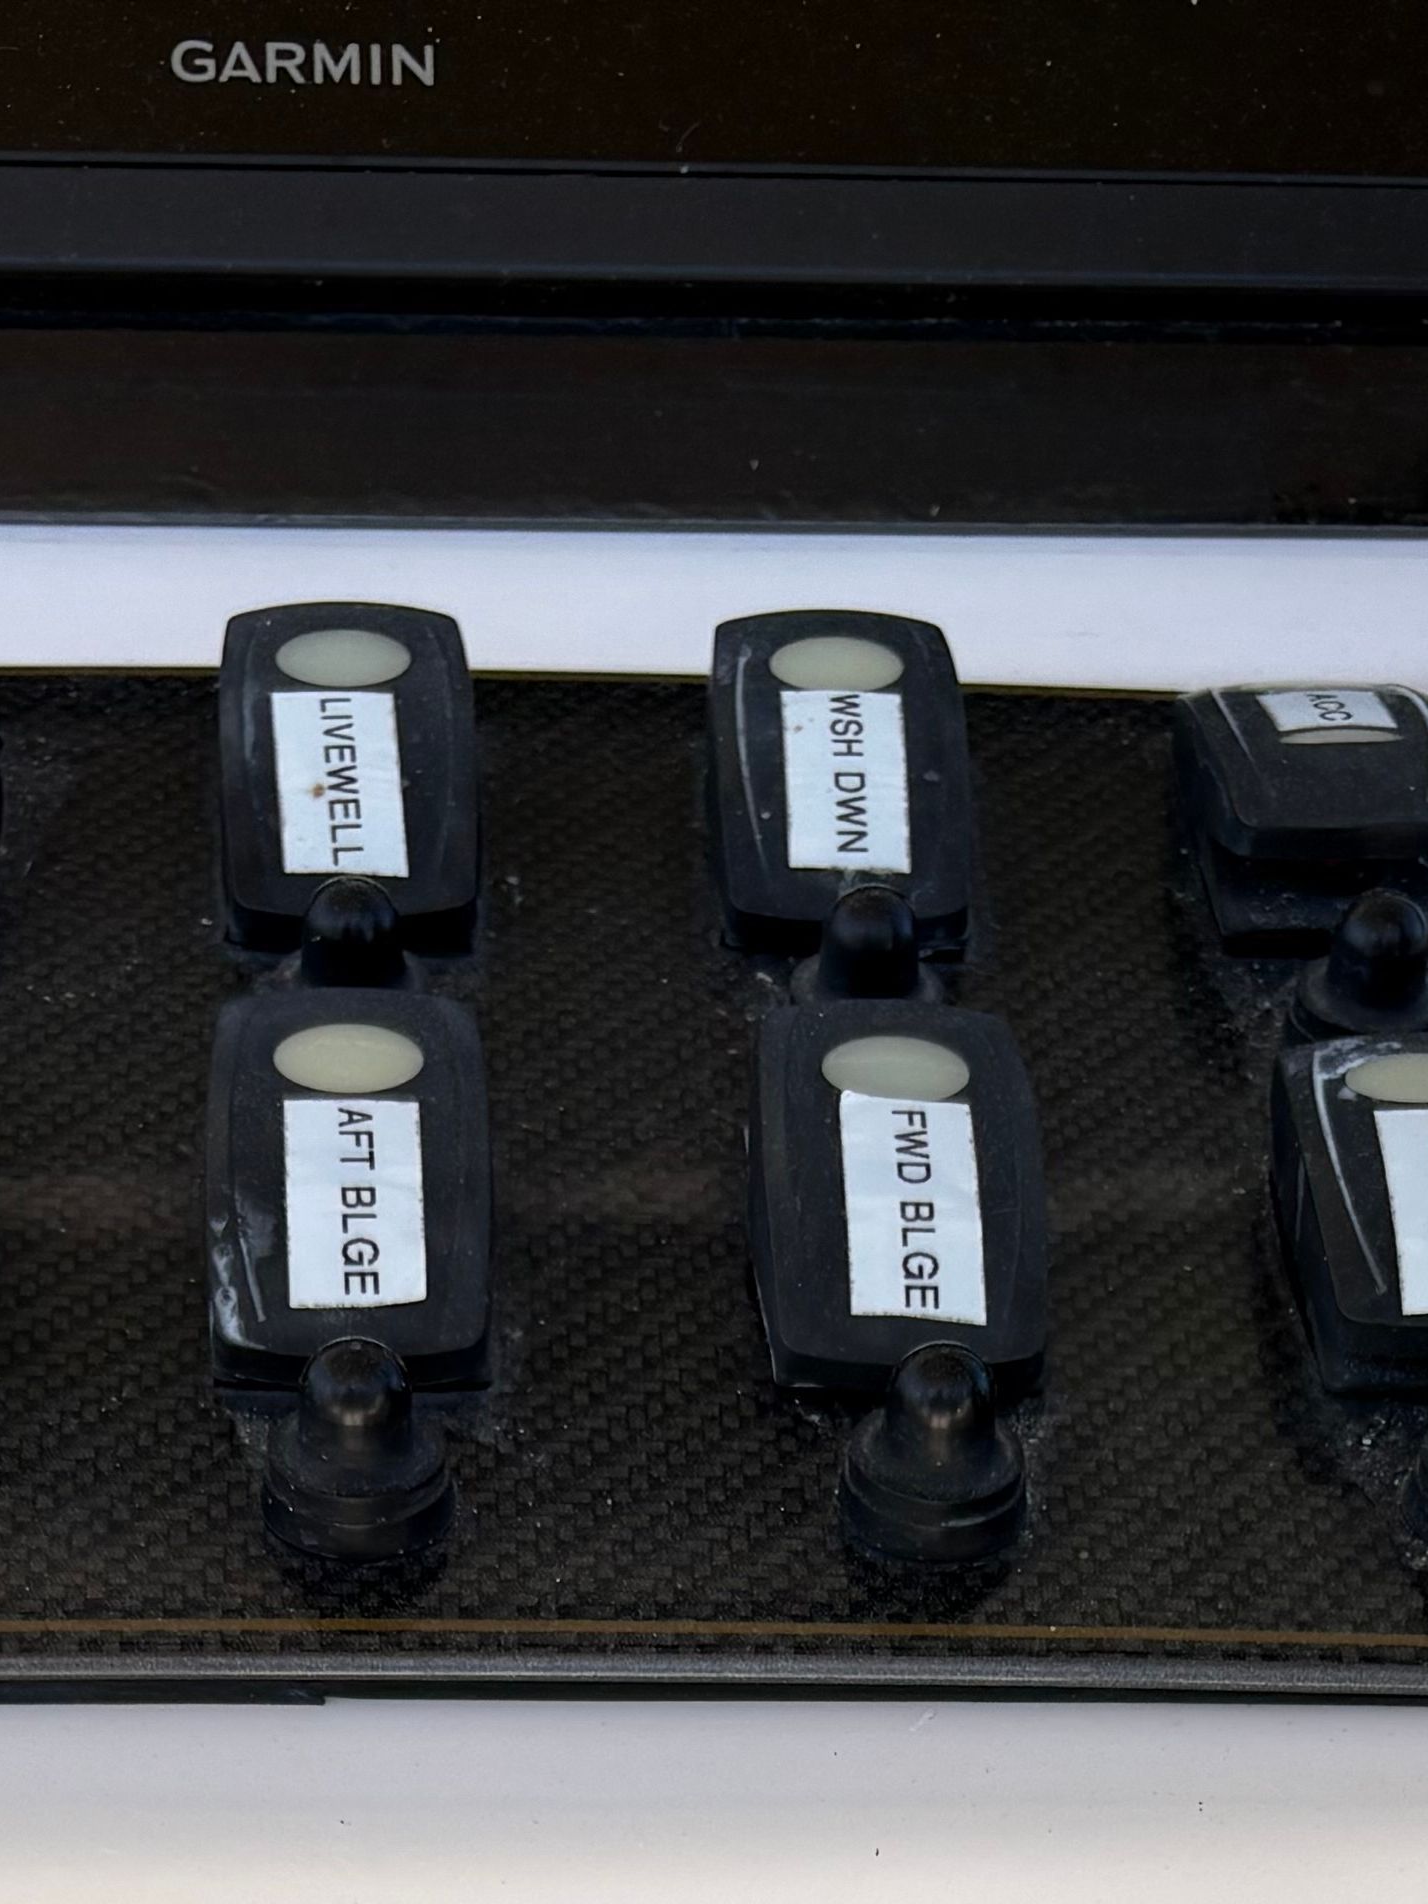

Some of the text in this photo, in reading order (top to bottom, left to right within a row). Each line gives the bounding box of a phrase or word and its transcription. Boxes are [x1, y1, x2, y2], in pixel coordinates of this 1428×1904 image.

[170, 38, 435, 87] GARMIN
[320, 698, 364, 867] LIVEWELL
[829, 694, 869, 853] WSH DWN
[1306, 694, 1353, 721] ACC
[337, 1107, 380, 1296] AFT BLGE
[891, 1109, 940, 1310] FWD BLGE
